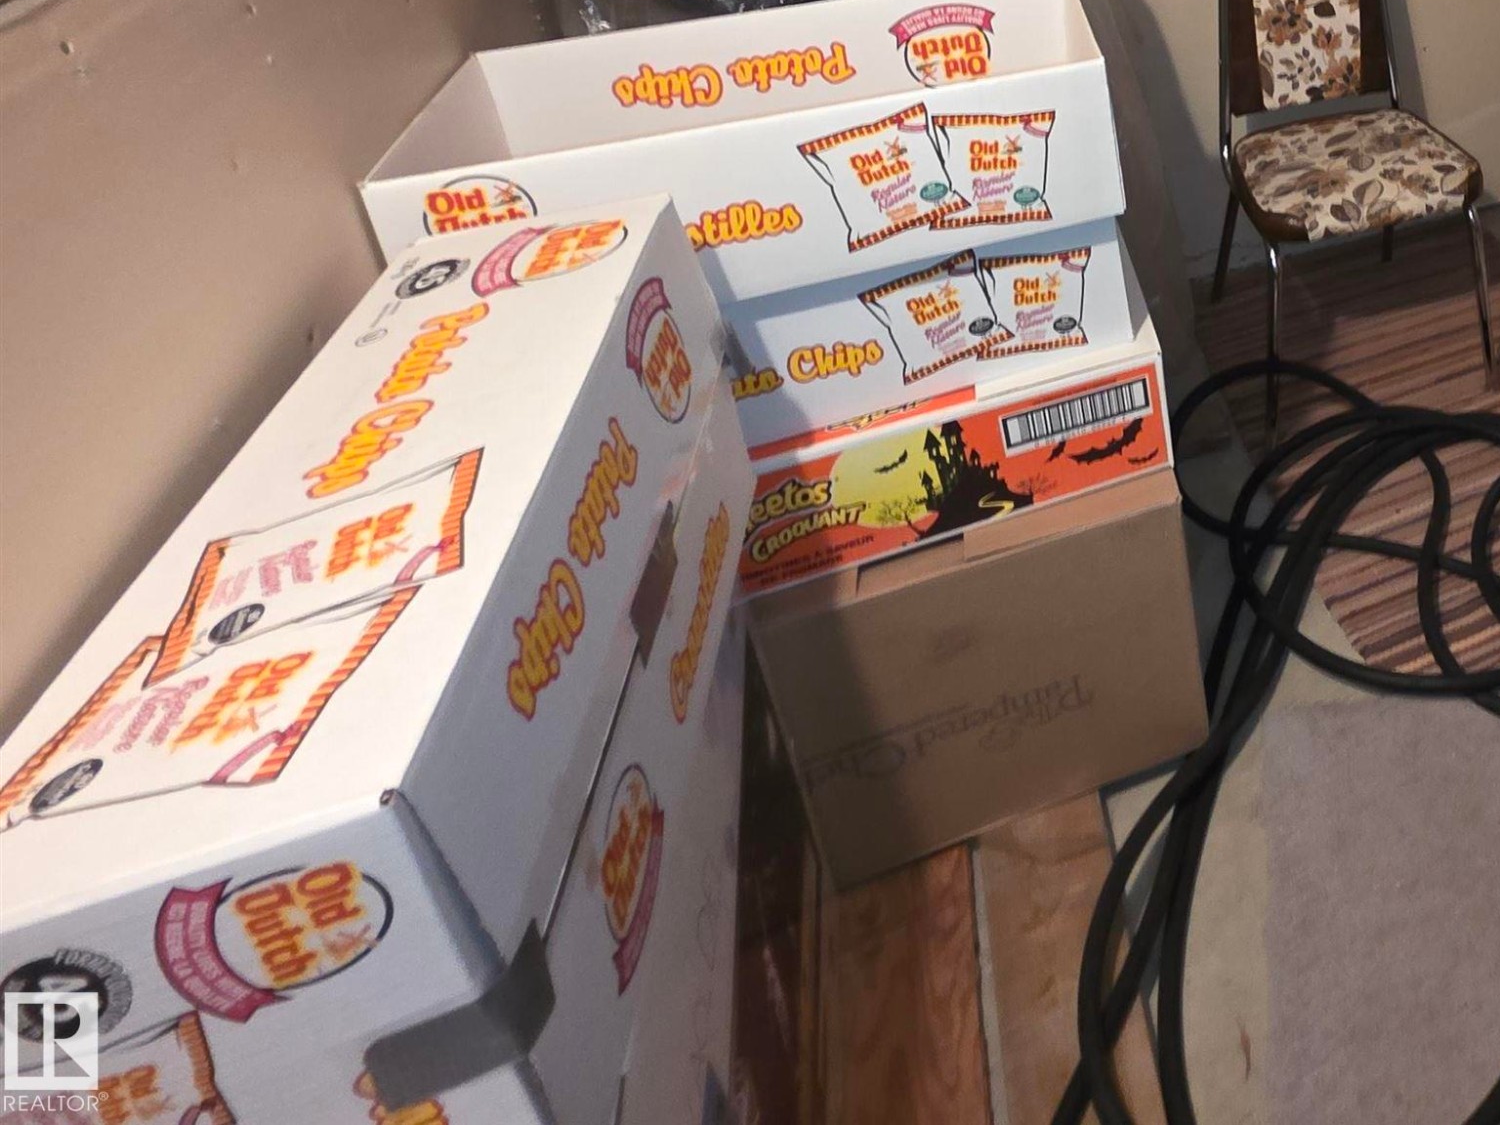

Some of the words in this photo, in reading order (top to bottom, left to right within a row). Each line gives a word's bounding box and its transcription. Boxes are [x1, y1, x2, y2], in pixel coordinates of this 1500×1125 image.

[727, 41, 857, 92] Potato
[912, 32, 983, 60] Dutch
[944, 55, 987, 79] Old
[612, 62, 724, 108] Chips
[850, 149, 885, 171] Old
[969, 139, 999, 156] Old
[969, 155, 1018, 172] Dutch
[857, 159, 911, 187] Dutch
[871, 173, 913, 203] Regular
[425, 187, 487, 217] Old
[524, 228, 583, 278] Dutch
[577, 220, 623, 249] Old
[906, 292, 938, 313] Old
[1012, 277, 1041, 293] Old
[1013, 289, 1058, 307] Dutch
[912, 298, 961, 326] Dutch
[374, 301, 490, 404] Potato
[643, 316, 680, 389] Dutch
[786, 338, 885, 385] Chips
[667, 356, 694, 398] Old
[302, 398, 435, 499] Chips
[567, 415, 639, 568] Potato
[369, 501, 415, 542] Old
[750, 501, 868, 563] CROQUANT
[324, 516, 374, 581] Dutch
[506, 558, 585, 723] Chips
[244, 651, 315, 704] Old
[171, 659, 274, 751] Dutch
[297, 861, 363, 928] Old
[235, 882, 318, 987] Dutch
